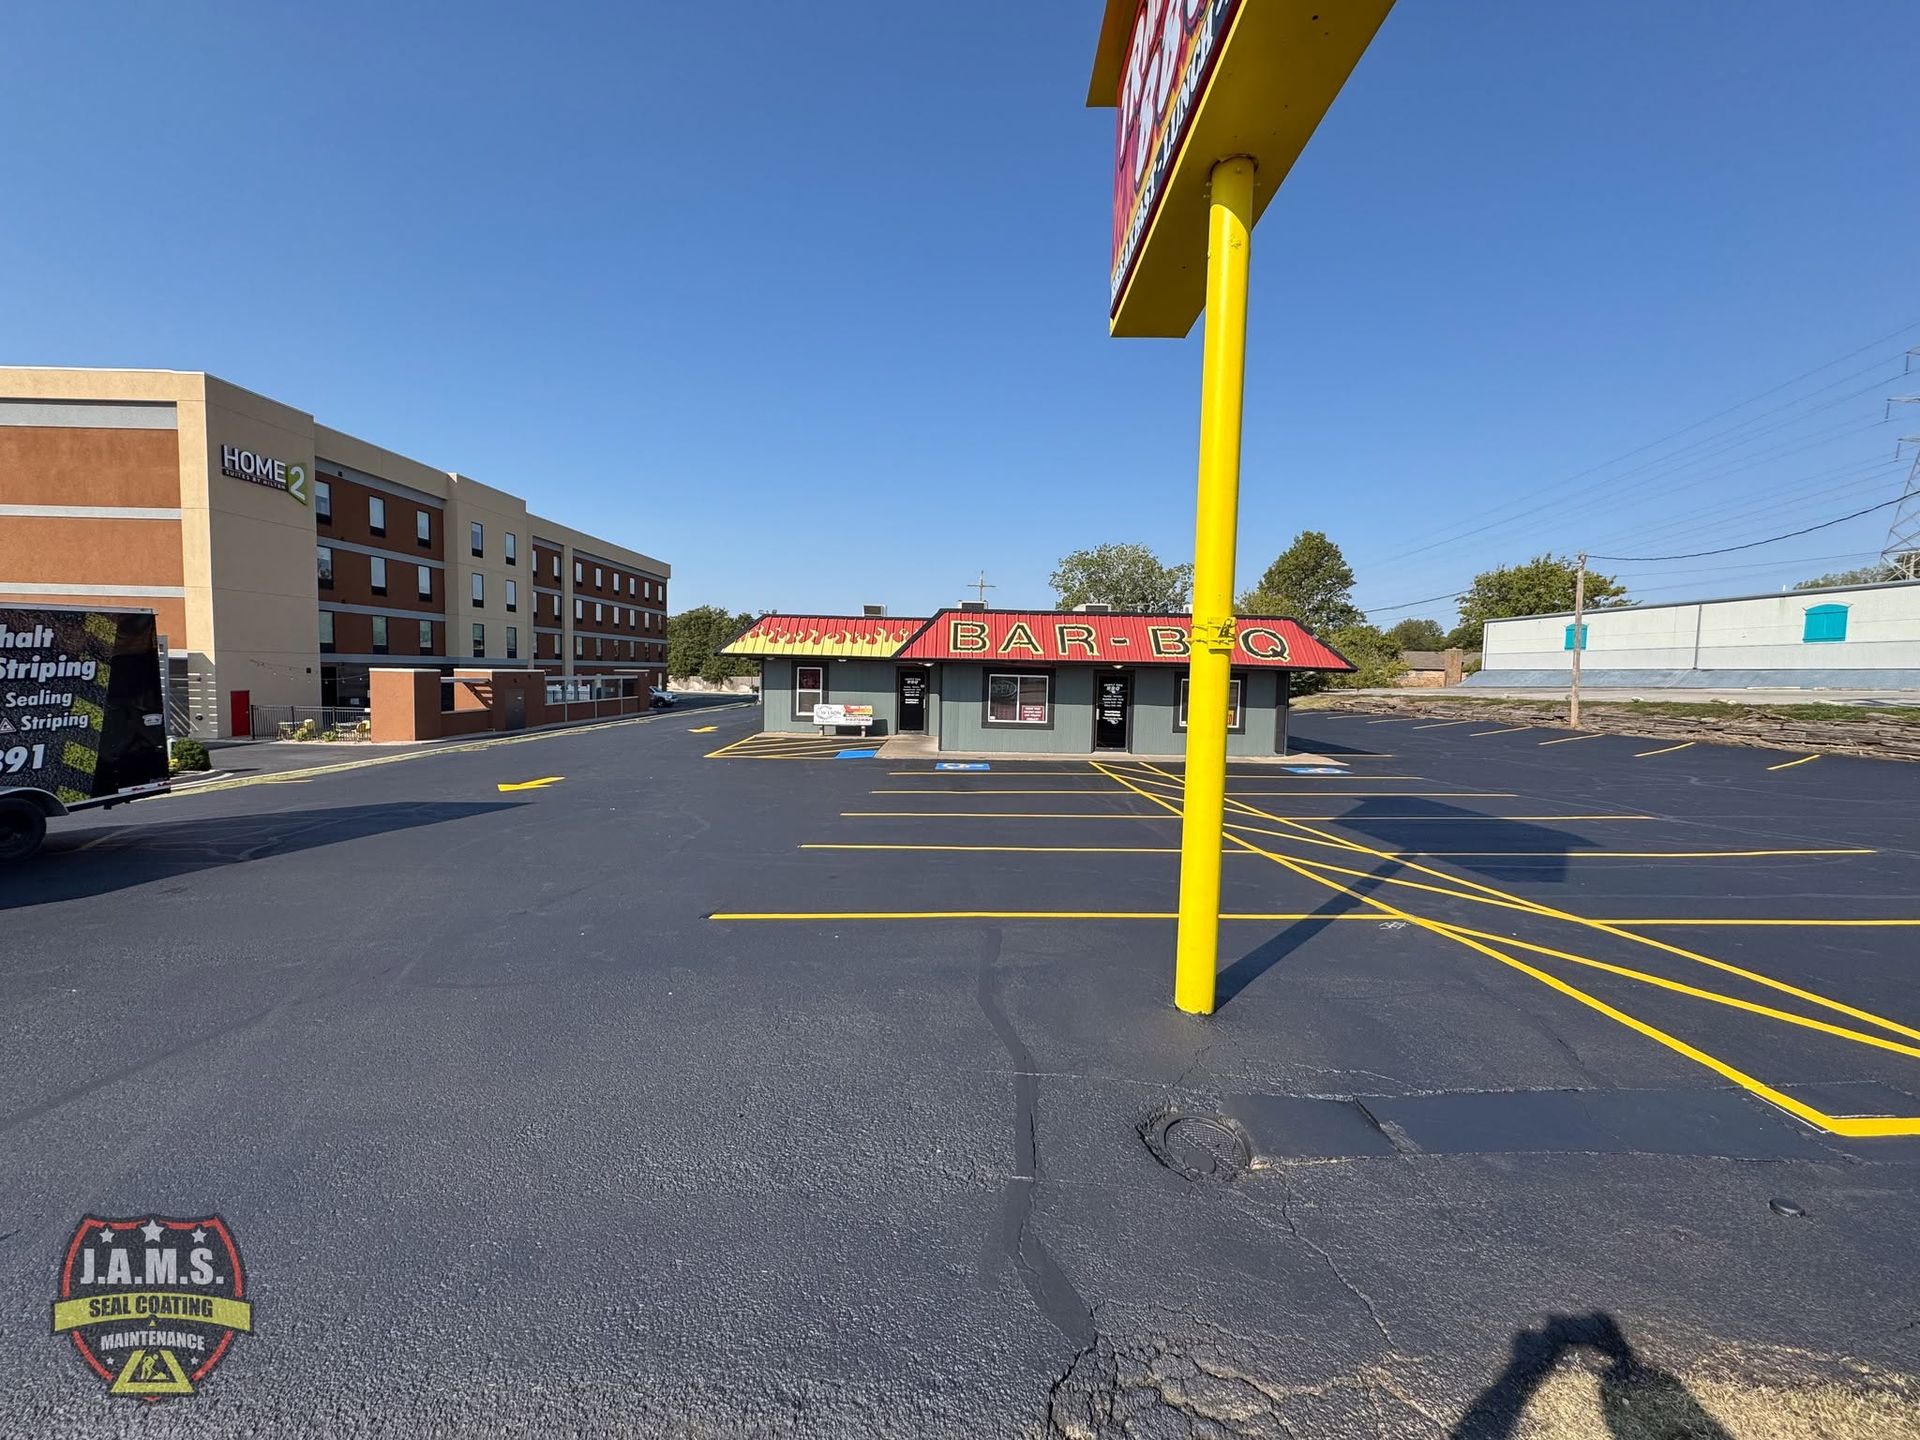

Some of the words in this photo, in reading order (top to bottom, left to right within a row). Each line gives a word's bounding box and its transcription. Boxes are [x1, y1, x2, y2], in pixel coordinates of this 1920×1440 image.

[1136, 0, 1199, 182] BB
[1162, 0, 1214, 170] LUNCH
[222, 445, 287, 483] HOME
[289, 465, 306, 501] 2
[5, 689, 73, 708] Sealing
[20, 711, 89, 732] Striping
[0, 743, 45, 774] 91
